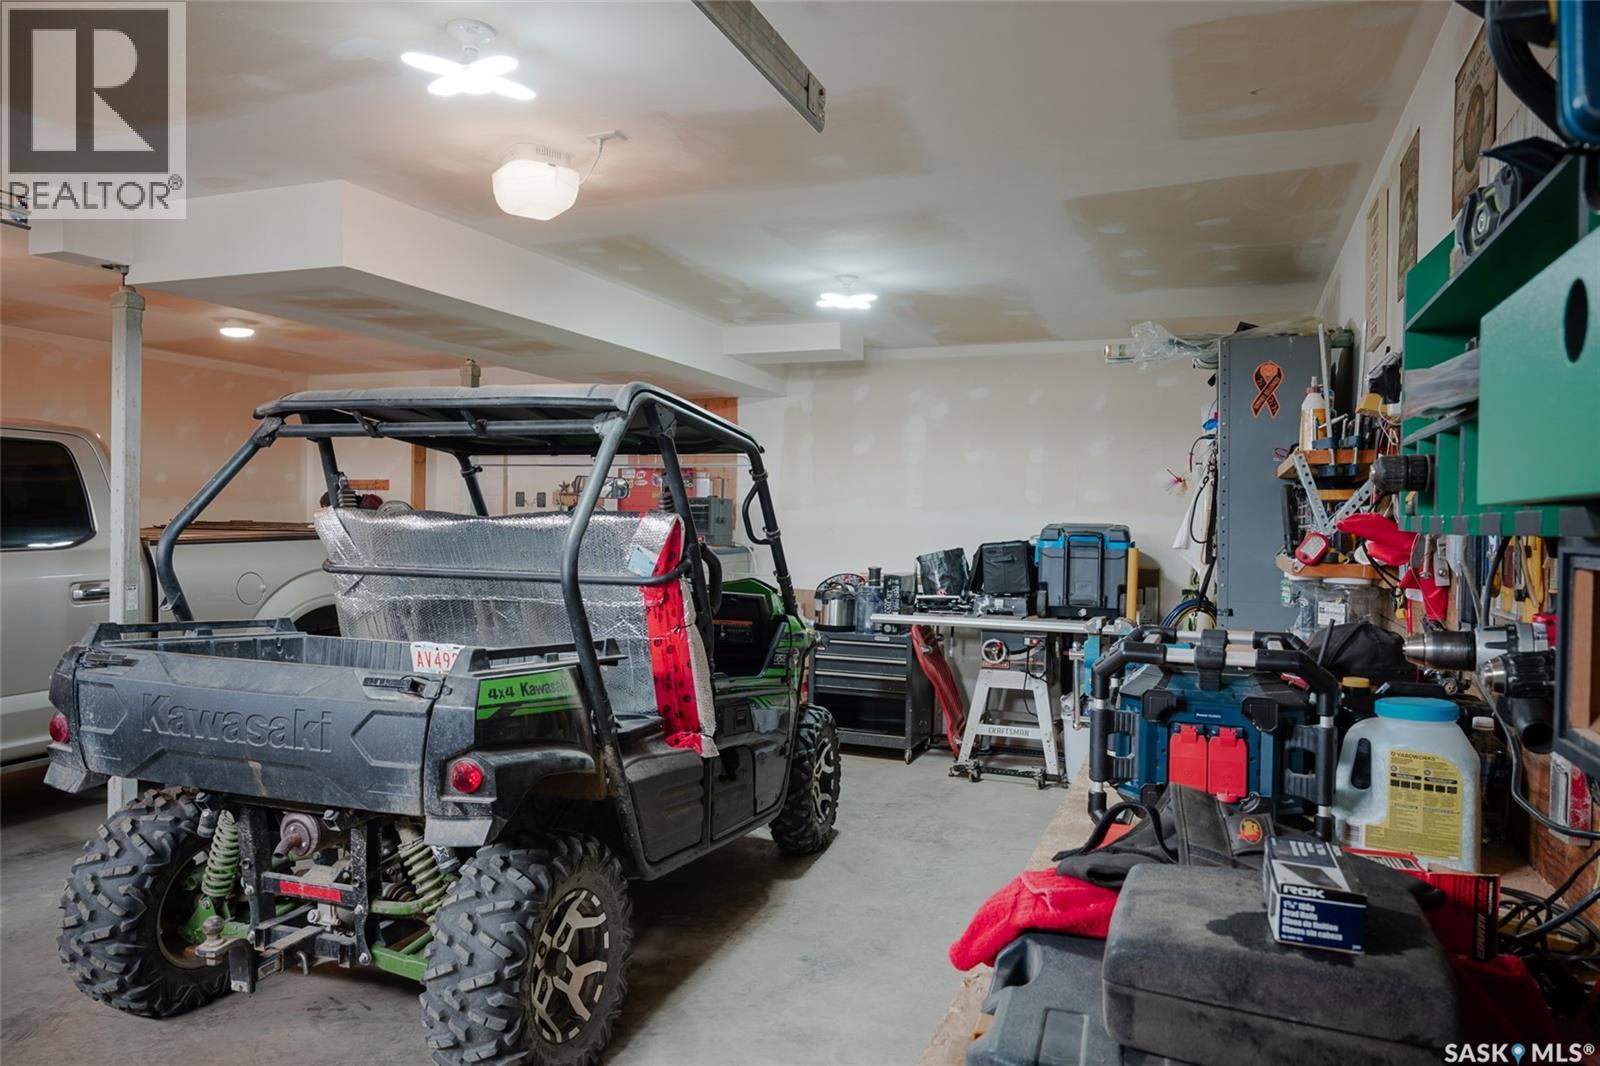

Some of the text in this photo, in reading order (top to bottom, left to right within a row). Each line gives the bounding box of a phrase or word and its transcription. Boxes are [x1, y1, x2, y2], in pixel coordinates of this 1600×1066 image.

[487, 686, 515, 700] 4x4
[142, 693, 333, 753] Kawasaki
[988, 727, 1030, 737] CRAFTSMAN
[1282, 884, 1326, 899] ROK
